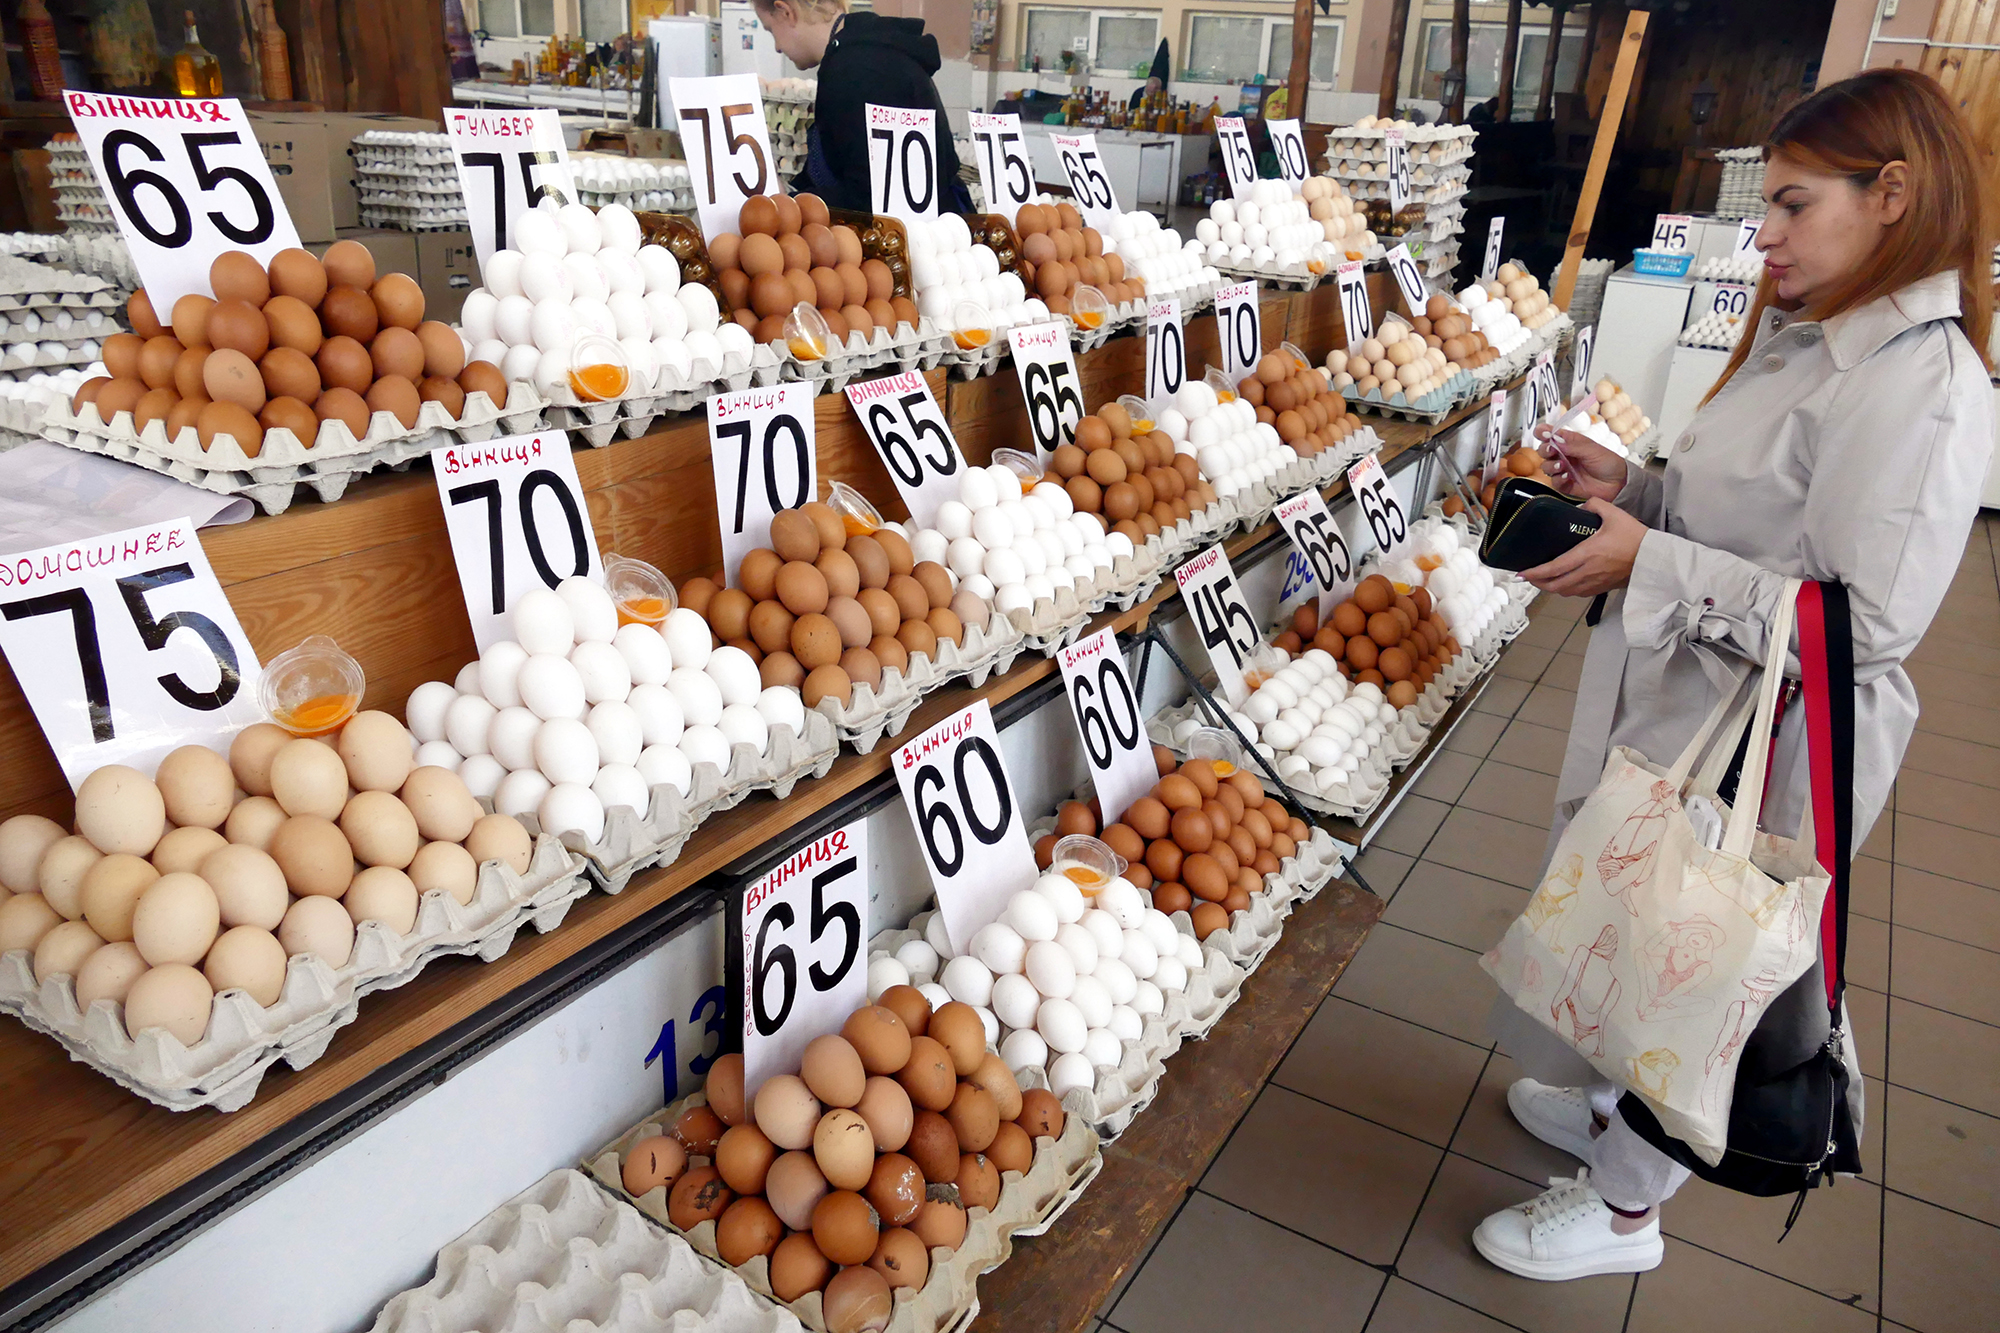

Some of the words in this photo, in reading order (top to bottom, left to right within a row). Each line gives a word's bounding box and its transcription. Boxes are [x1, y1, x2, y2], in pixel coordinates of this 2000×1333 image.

[102, 129, 274, 248] 65
[679, 103, 767, 204] 75
[871, 128, 934, 214] 70
[974, 132, 1030, 204] 75
[1062, 150, 1112, 210] 65
[1220, 131, 1254, 184] 75
[1273, 133, 1305, 181] 80
[1390, 147, 1409, 199] 45
[461, 151, 570, 251] 75
[1655, 224, 1687, 248] 45
[1219, 302, 1257, 373] 70
[1342, 281, 1369, 341] 70
[1713, 290, 1747, 314] 60
[1149, 322, 1182, 399] 70
[1540, 362, 1558, 413] 60
[868, 392, 957, 488] 65
[1025, 362, 1084, 452] 65
[716, 414, 811, 534] 70
[1360, 478, 1405, 554] 65
[448, 469, 589, 615] 70
[1294, 512, 1350, 592] 65
[0, 562, 241, 743] 75
[1192, 575, 1259, 671] 45
[1073, 658, 1139, 770] 60
[914, 736, 1012, 878] 60
[752, 856, 861, 1036] 65
[644, 985, 727, 1106] 13
